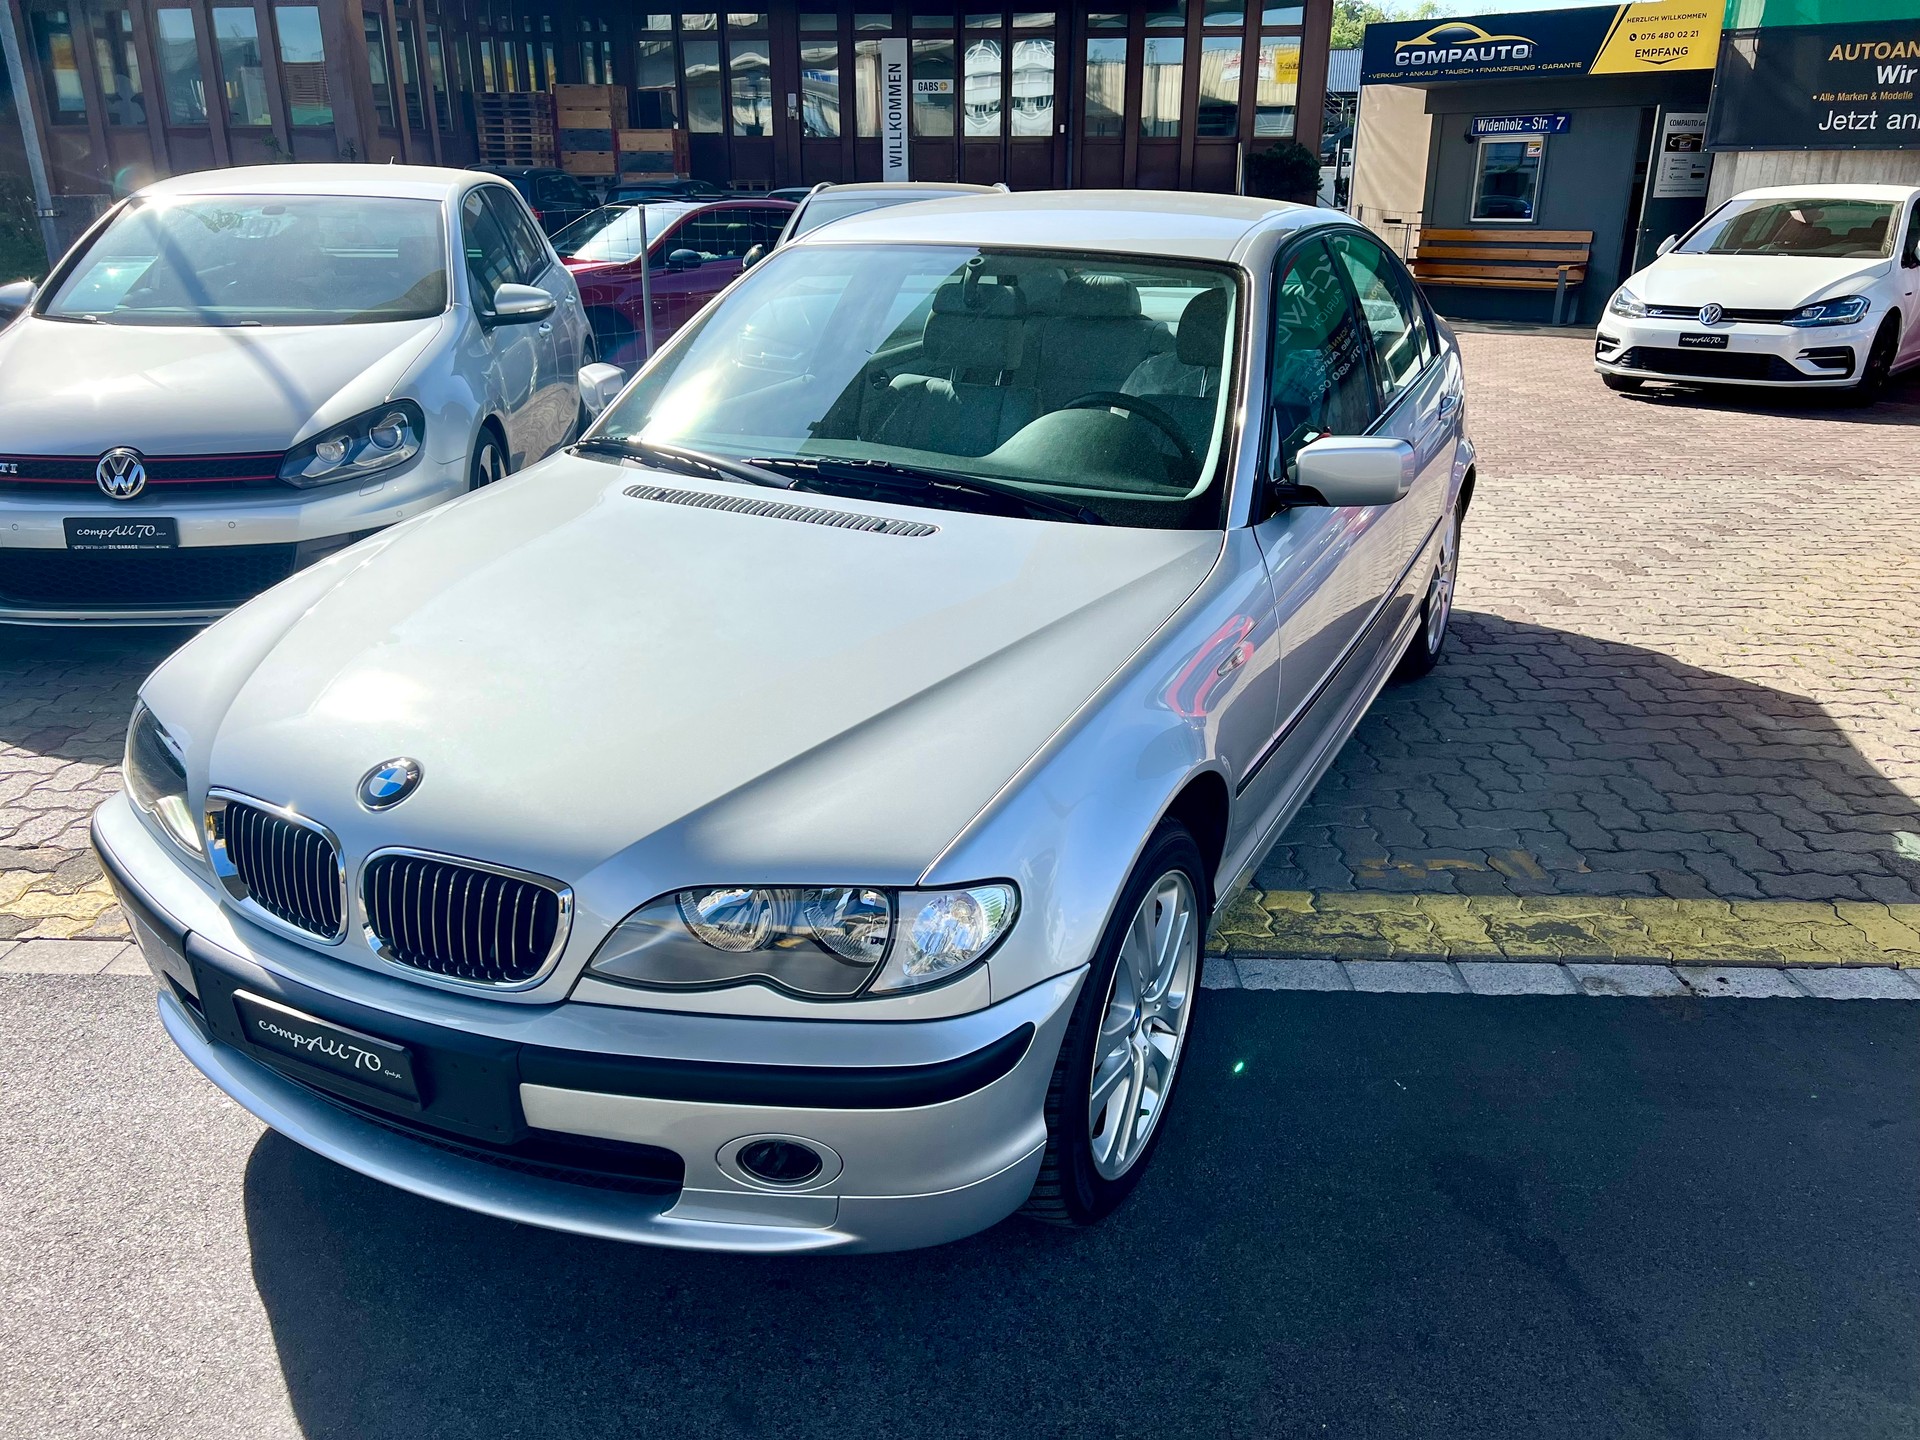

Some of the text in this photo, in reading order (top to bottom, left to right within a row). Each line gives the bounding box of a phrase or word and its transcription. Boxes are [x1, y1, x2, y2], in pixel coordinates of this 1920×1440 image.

[1626, 12, 1708, 24] HERZLICH WILLKOMMEN
[1640, 33, 1656, 41] 076
[1658, 31, 1675, 39] 480
[1395, 44, 1529, 66] COMPAUTO
[1634, 46, 1689, 58] EMPFANG
[1828, 40, 1920, 61] AUTOAN
[1371, 71, 1404, 79] VERKAUF
[1409, 69, 1439, 77] ANKAUF
[1479, 64, 1536, 73] FINANZIERUNG
[1542, 61, 1582, 70] GARANTIE
[1876, 64, 1918, 85] Wir
[918, 81, 939, 92] GABS
[1819, 90, 1914, 102] Alle Marken & Modelle
[888, 63, 903, 169] WILLKOMMEN
[1556, 116, 1566, 130] 7
[1669, 119, 1698, 127] COMPAUTO
[1818, 110, 1920, 131] Jetzt an
